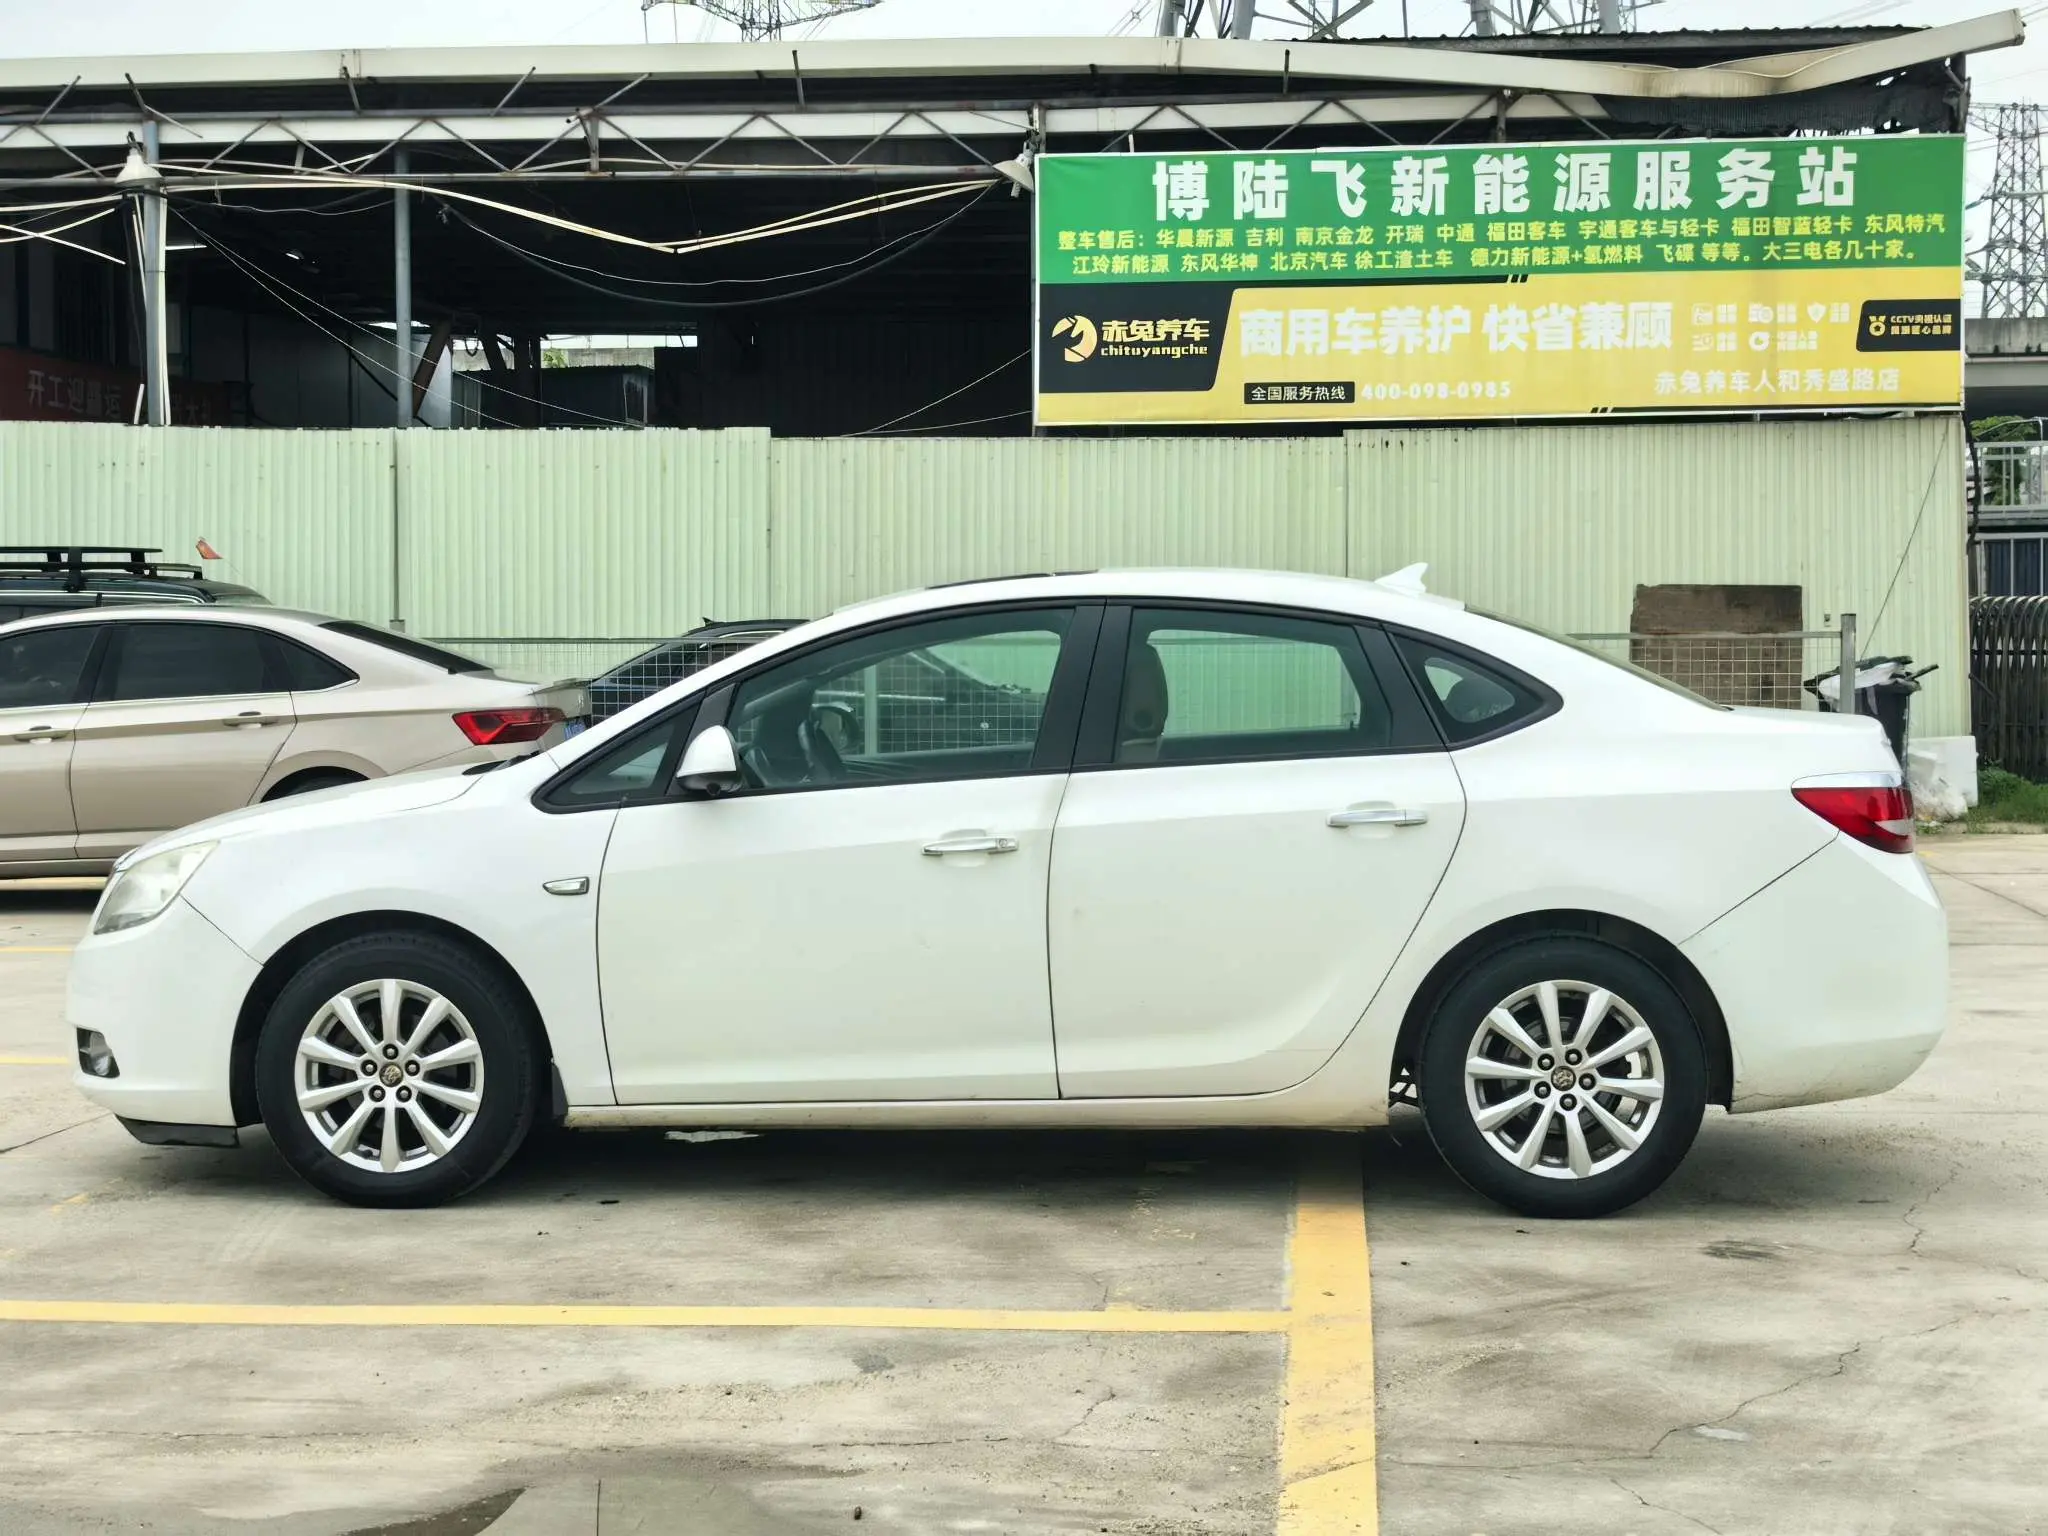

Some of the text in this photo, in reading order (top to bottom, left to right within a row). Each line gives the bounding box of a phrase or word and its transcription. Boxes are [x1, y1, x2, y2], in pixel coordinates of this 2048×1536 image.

[1152, 146, 1857, 221] 博陆飞新能源服务站
[1245, 227, 1284, 247] 吉利
[1296, 225, 1375, 247] 南京金龙
[1386, 224, 1425, 245] 开瑞
[1436, 222, 1476, 244] 中通
[1486, 221, 1567, 242] 福田客车
[1578, 218, 1720, 240] 宇通客车与轻卡
[1731, 215, 1853, 237] 福田智蓝轻卡
[1864, 213, 1946, 234] 东风特汽
[1270, 250, 1349, 272] 北京汽车
[1354, 248, 1454, 270] 徐工渣土车
[1101, 318, 1210, 343] 赤兔养车
[1238, 304, 1471, 358] 商用车养护
[1482, 300, 1674, 353] 快省兼顾
[1101, 343, 1208, 359] chituyangche
[1251, 381, 1512, 401] 全国服务热线 400-098-0985
